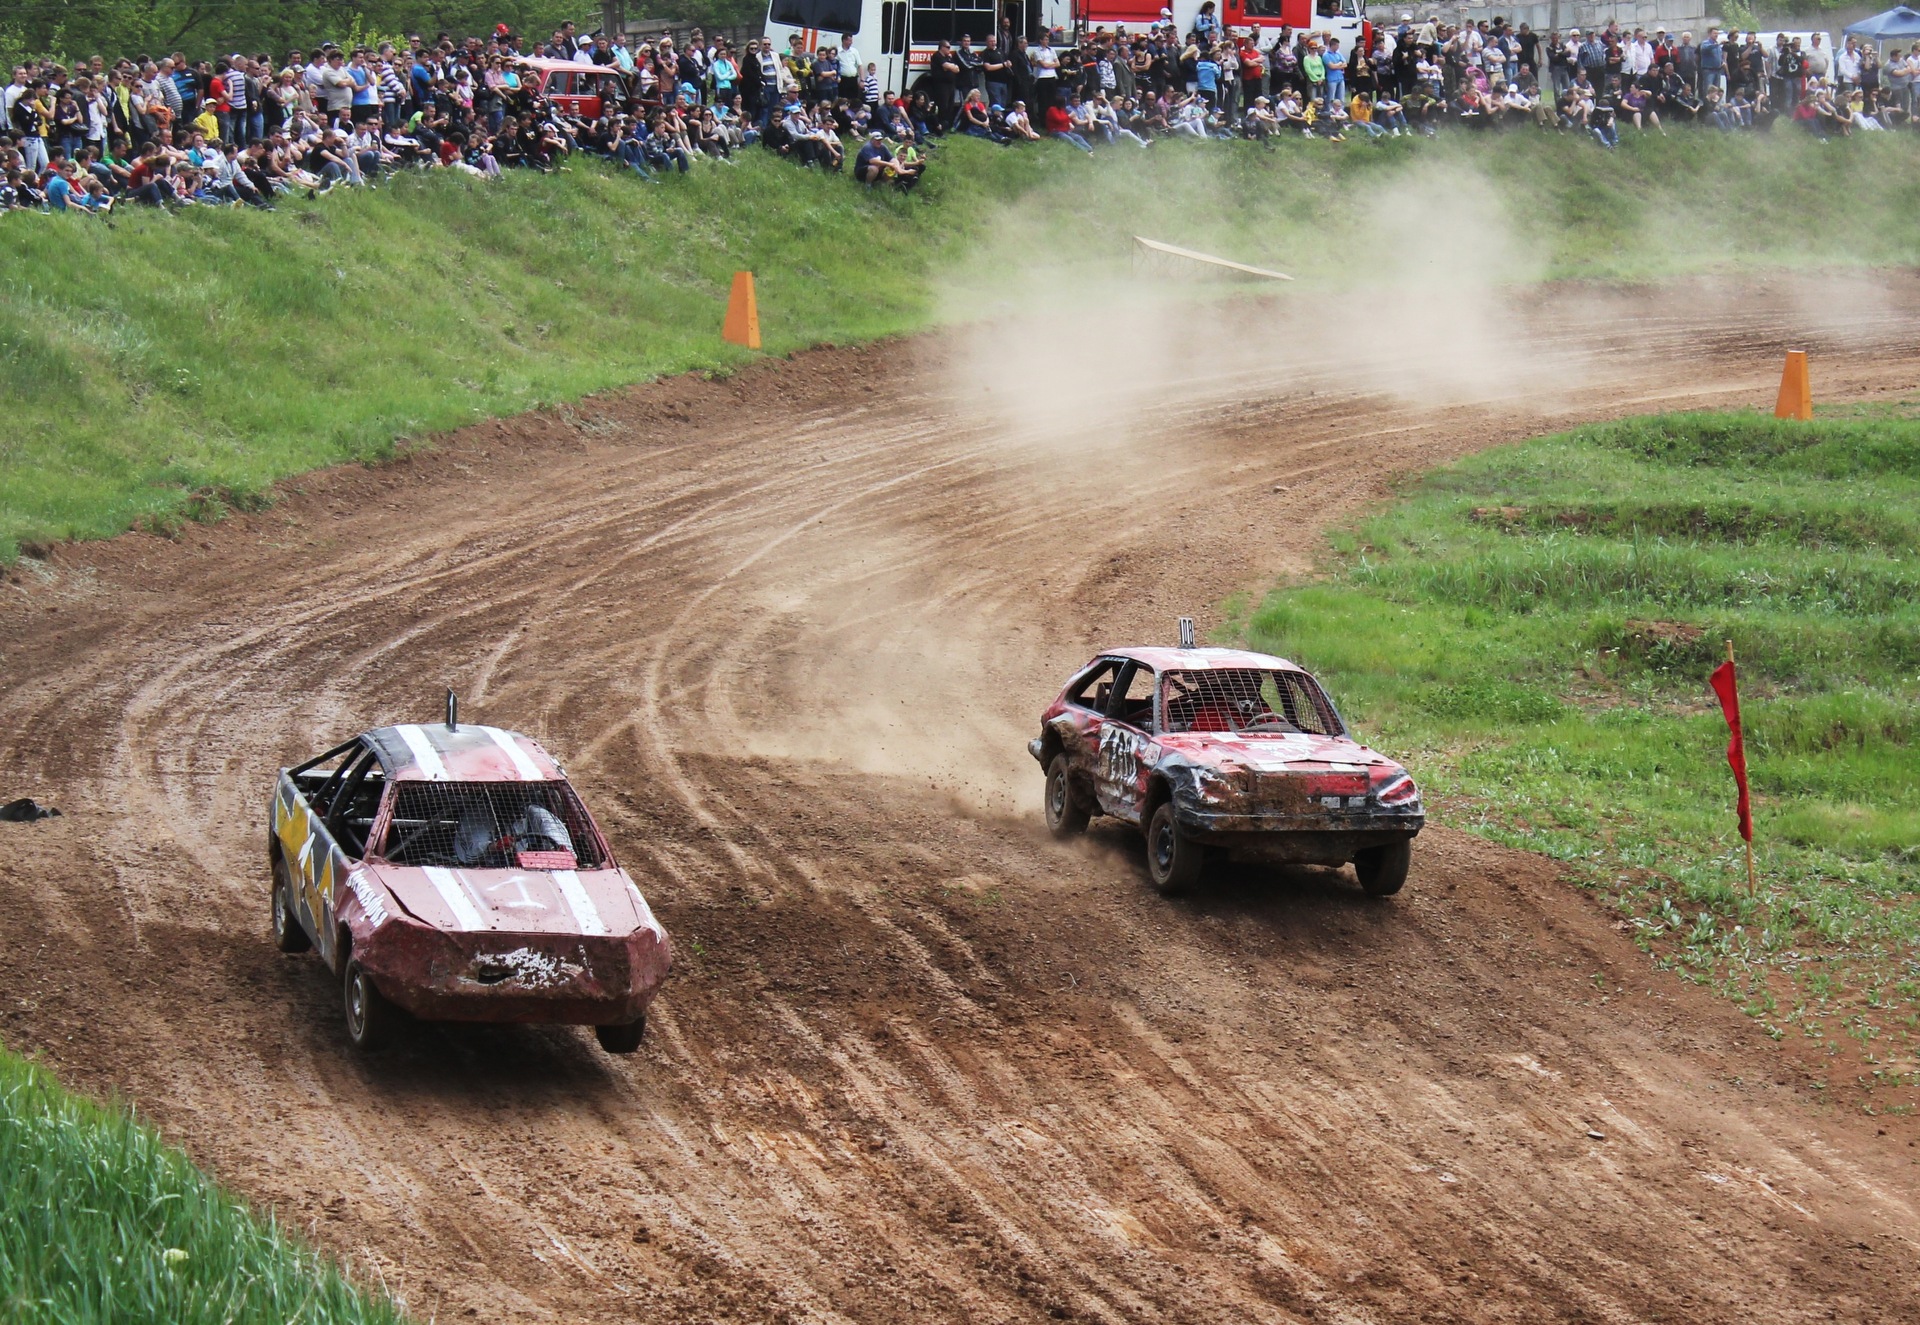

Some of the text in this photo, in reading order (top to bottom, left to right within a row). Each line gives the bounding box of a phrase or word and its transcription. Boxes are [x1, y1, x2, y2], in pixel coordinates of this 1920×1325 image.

[910, 53, 934, 62] ОПЕРА
[1180, 618, 1194, 645] 108
[485, 876, 547, 909] 1
